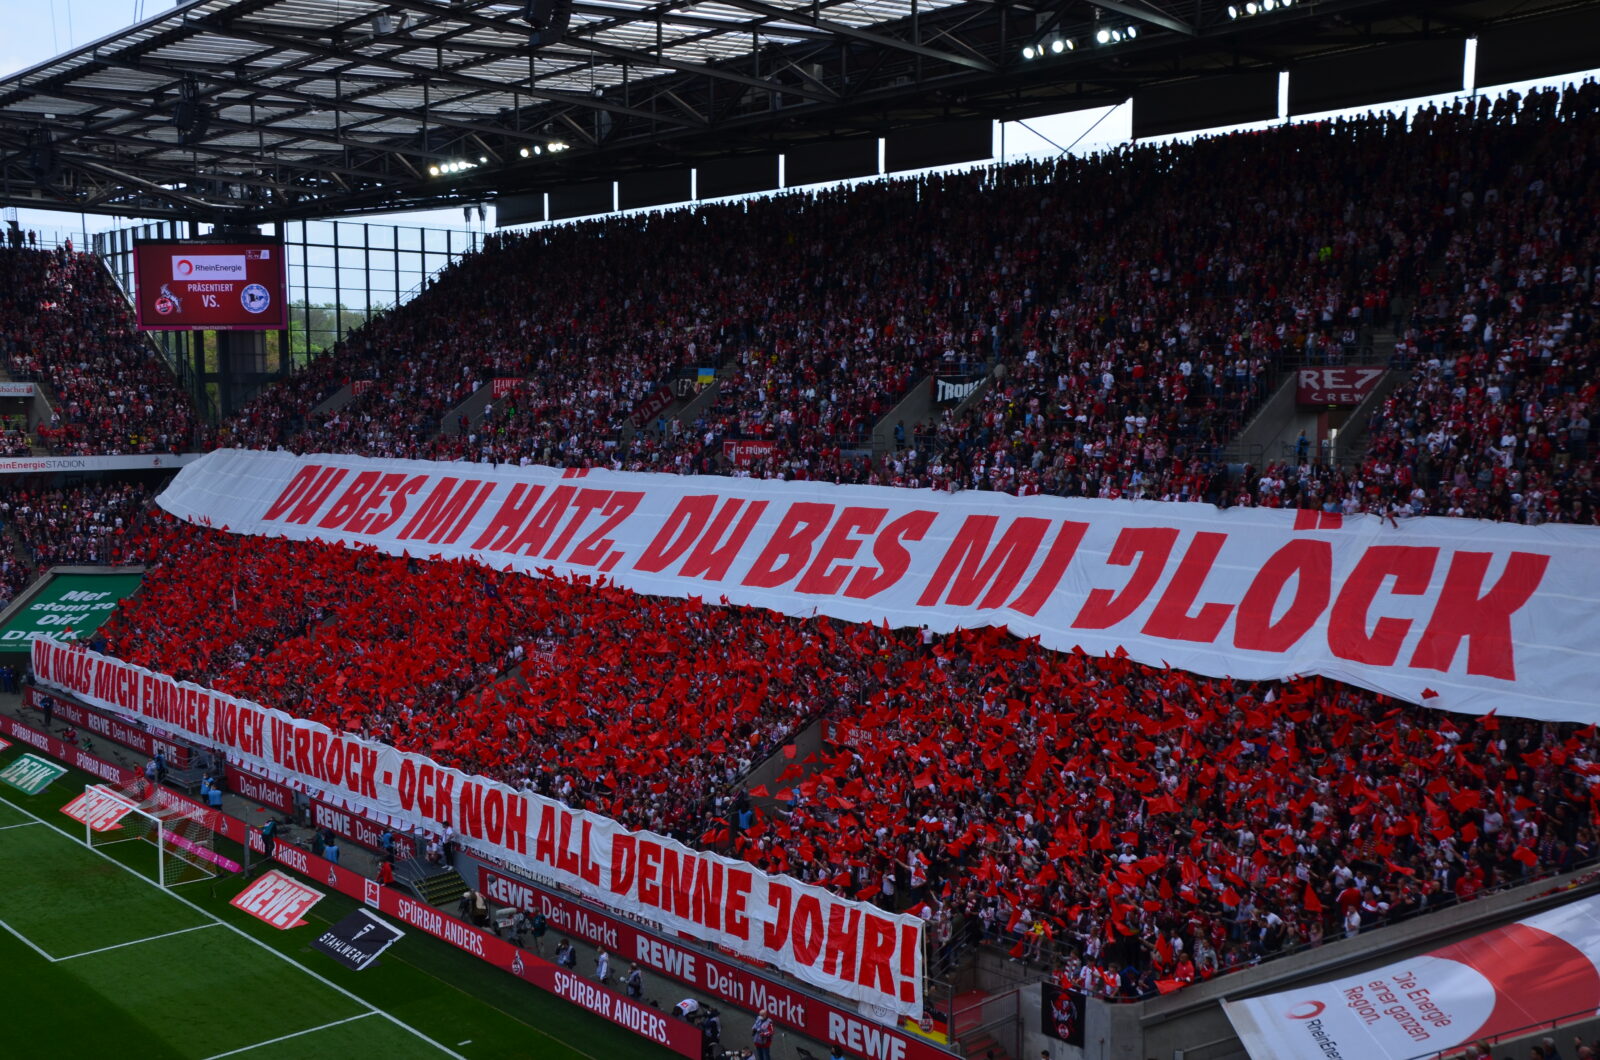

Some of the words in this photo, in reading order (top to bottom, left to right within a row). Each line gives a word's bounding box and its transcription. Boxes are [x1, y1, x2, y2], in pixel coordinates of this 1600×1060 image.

[195, 264, 242, 272] RheinEnergie
[187, 283, 233, 292] PRÄSENTIERT
[202, 294, 220, 308] VS.
[937, 377, 987, 402] TROIK
[262, 465, 349, 524] DU
[317, 471, 430, 534] BES
[396, 477, 498, 544] MI
[470, 467, 646, 572] HÄTZ,
[633, 495, 770, 581] DU
[741, 502, 939, 599] BES
[916, 515, 1089, 617] MI
[1070, 508, 1551, 681] JLÖCK
[30, 602, 88, 612] stonn
[90, 602, 116, 611] zo
[59, 590, 112, 602] Mer
[1, 629, 84, 640] DEVK
[36, 613, 90, 626] Dir!
[88, 713, 110, 735] REWE
[112, 722, 126, 741] Dein
[127, 727, 146, 750] Markt
[0, 758, 55, 791] DEVK
[239, 776, 257, 798] Dein
[259, 783, 284, 807] Markt
[35, 640, 51, 680] DU
[94, 660, 139, 711] MICH
[143, 676, 211, 738] EMMER
[213, 698, 265, 758] NOCH
[399, 759, 454, 827] OCH
[459, 781, 527, 855] NOH
[536, 805, 600, 886] ALL
[611, 833, 752, 941] DENNE
[763, 882, 918, 1004] JOHR!
[65, 789, 127, 829] REWE
[316, 804, 351, 837] REWE
[356, 821, 377, 847] Dein
[12, 723, 31, 744] SPÜRBAR
[31, 733, 49, 752] ANDERS.
[77, 752, 99, 775] SPÜRBAR
[100, 763, 121, 784] ANDERS.
[278, 844, 309, 873] ANDERS.
[398, 899, 442, 937] SPÜRBAR
[444, 921, 486, 958] ANDERS.
[554, 972, 610, 1017] SPÜRBAR
[614, 1003, 671, 1045] ANDERS.
[236, 874, 315, 926] REWE
[319, 932, 368, 964] STAHLWERK
[487, 873, 535, 912] REWE
[542, 895, 571, 928] Dein
[575, 910, 618, 949] Markt
[636, 935, 697, 983] REWE
[706, 962, 744, 1000] Dein
[750, 981, 805, 1028] Markt
[828, 1011, 907, 1060] REWE
[1343, 986, 1381, 1026] Region.
[1368, 980, 1399, 1005] einer
[1392, 971, 1417, 990] Die
[1407, 989, 1452, 1028] Energie
[1383, 1005, 1431, 1042] ganzen
